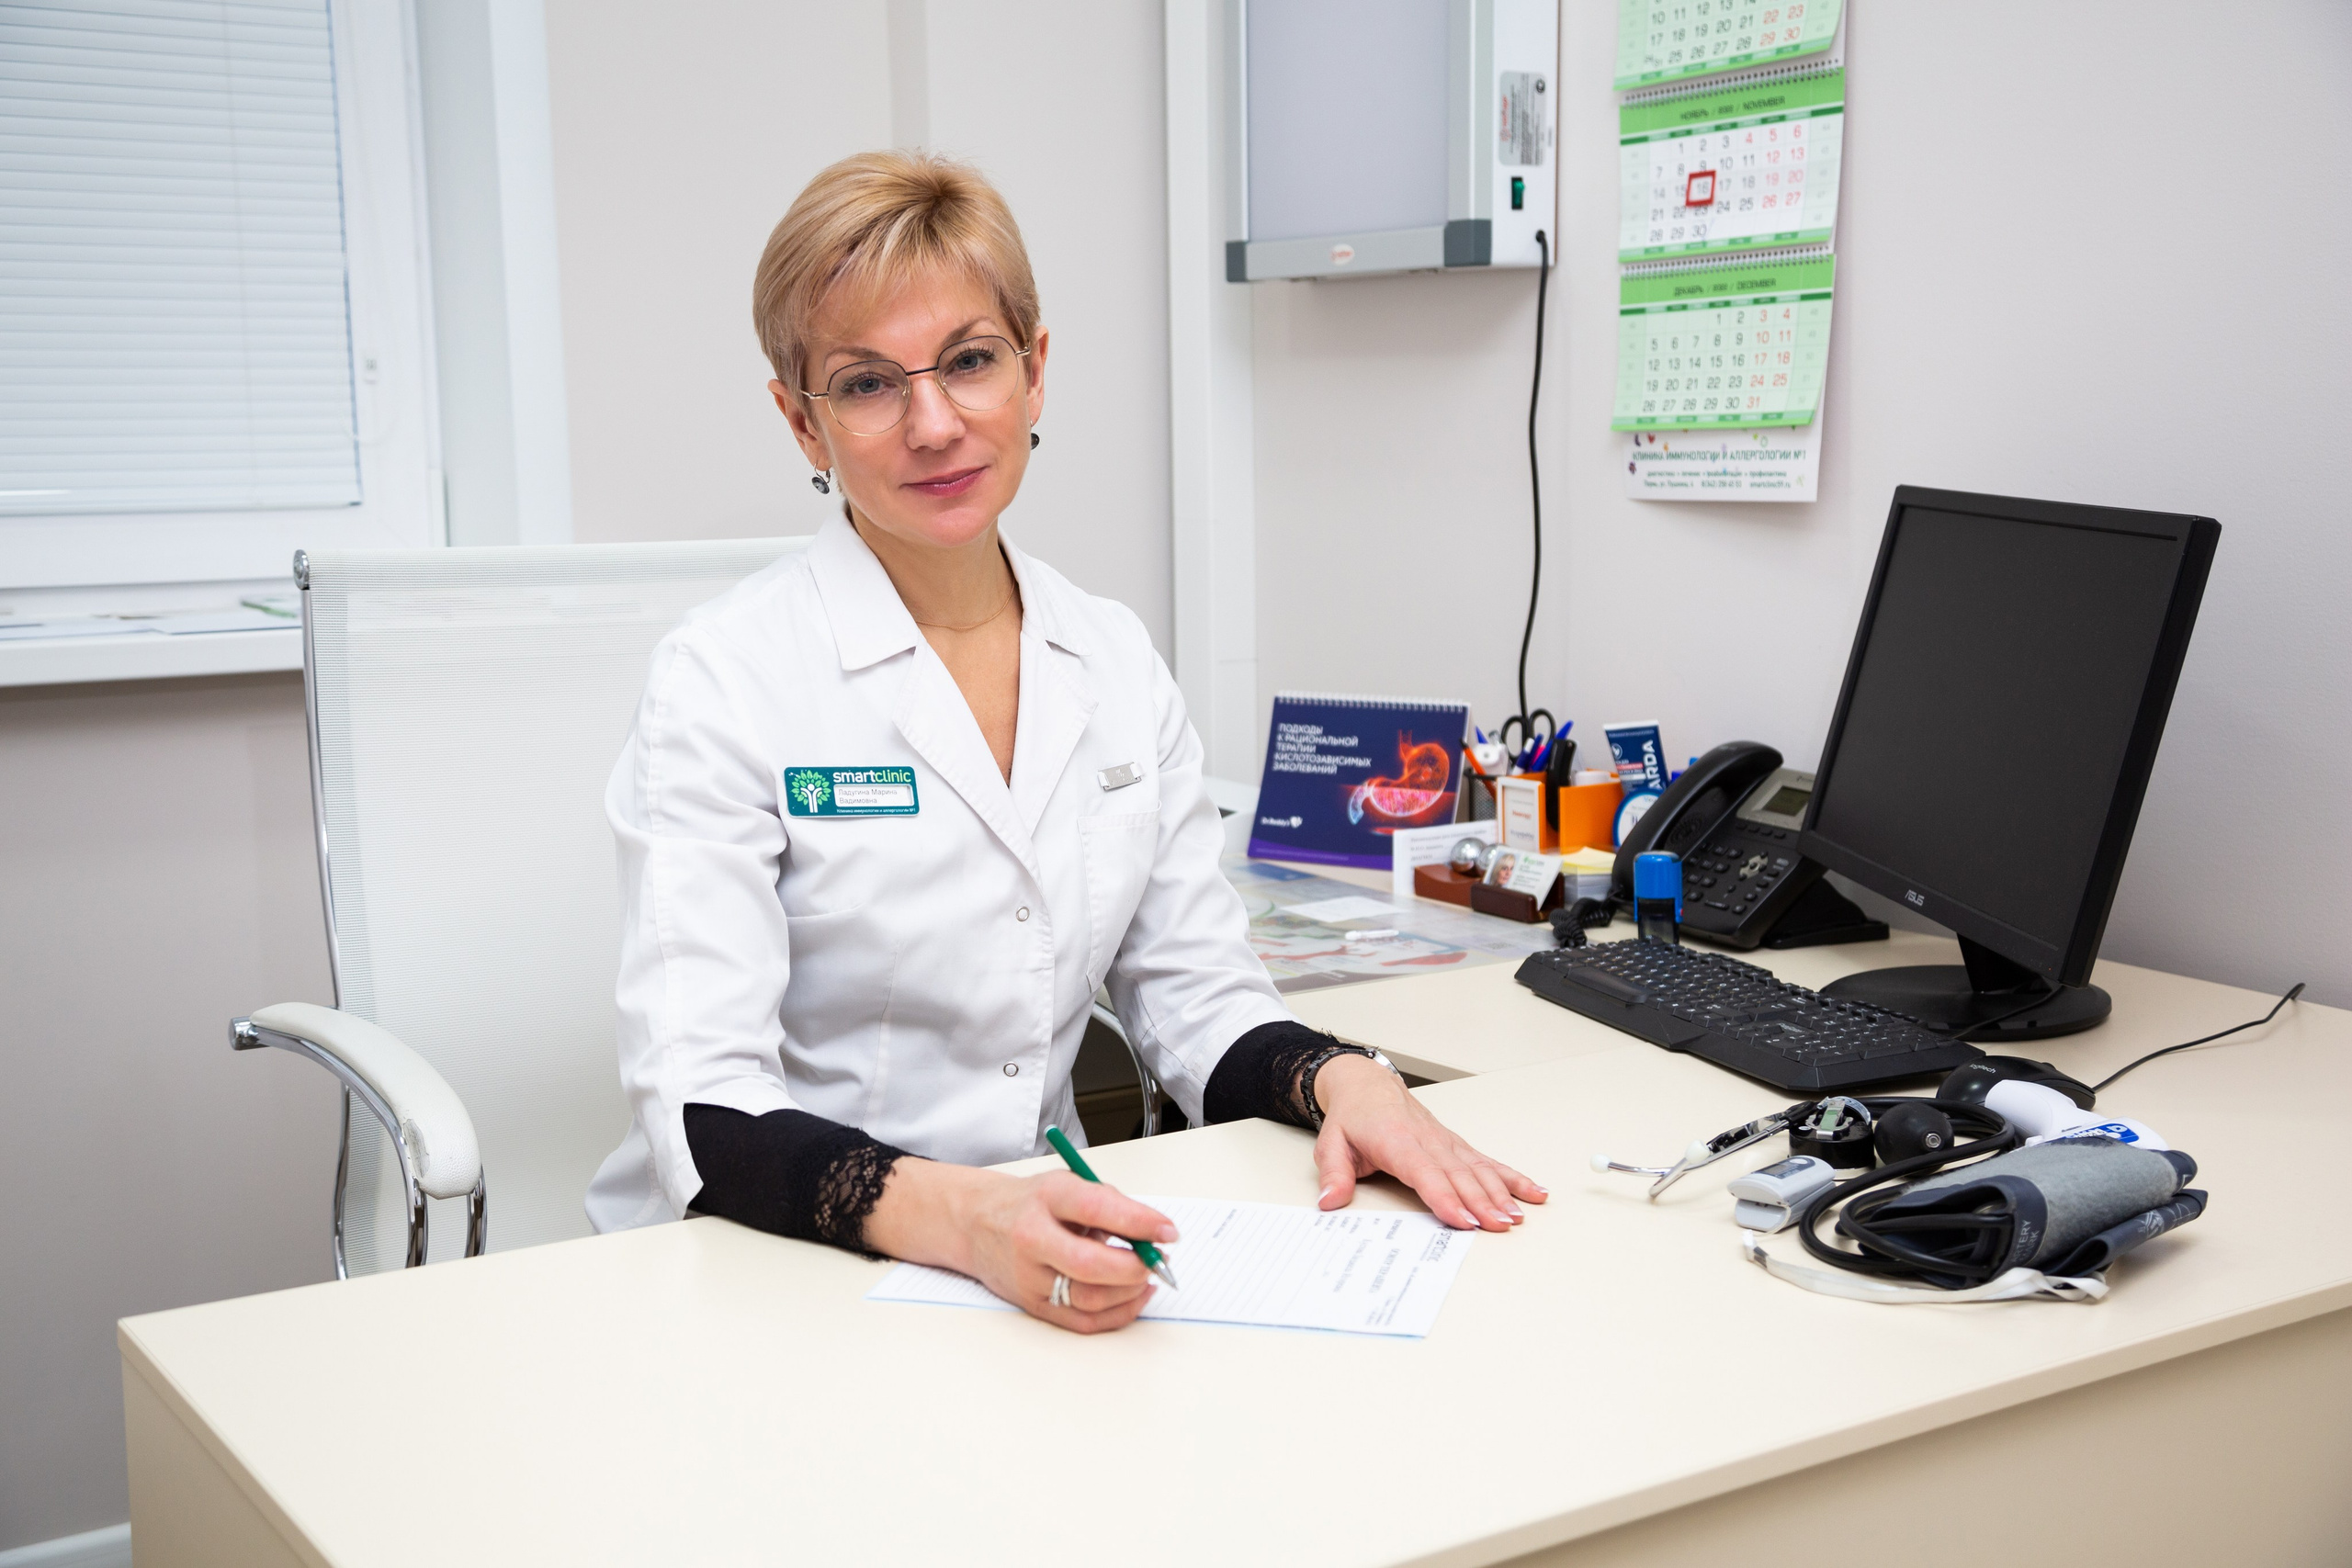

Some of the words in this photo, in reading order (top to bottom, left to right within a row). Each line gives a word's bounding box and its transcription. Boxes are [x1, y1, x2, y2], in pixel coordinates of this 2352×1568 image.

[1743, 96, 1785, 110] NOVEMBER
[1736, 278, 1776, 290] DECEMBER
[1633, 451, 1664, 461] КЛИНИКА
[1666, 450, 1720, 461] ИММУНОЛОГИИ
[1722, 450, 1727, 460] И
[1730, 449, 1792, 460] АЛЛЕРГОЛОГИИ
[1279, 723, 1323, 735] ПОДХОДЫ
[1277, 734, 1283, 742] К
[1284, 734, 1359, 747] РАЦИОНАЛЬНОЙ
[1276, 742, 1317, 753] ТЕРАПИИ
[1274, 752, 1372, 767] КИСЛОТОЗАВИСИМЫХ
[1272, 761, 1338, 774] ЗАБОЛЕВАНИЙ
[832, 769, 911, 784] smartclinic
[871, 788, 897, 796] Марина
[1905, 889, 1925, 907] ASUS
